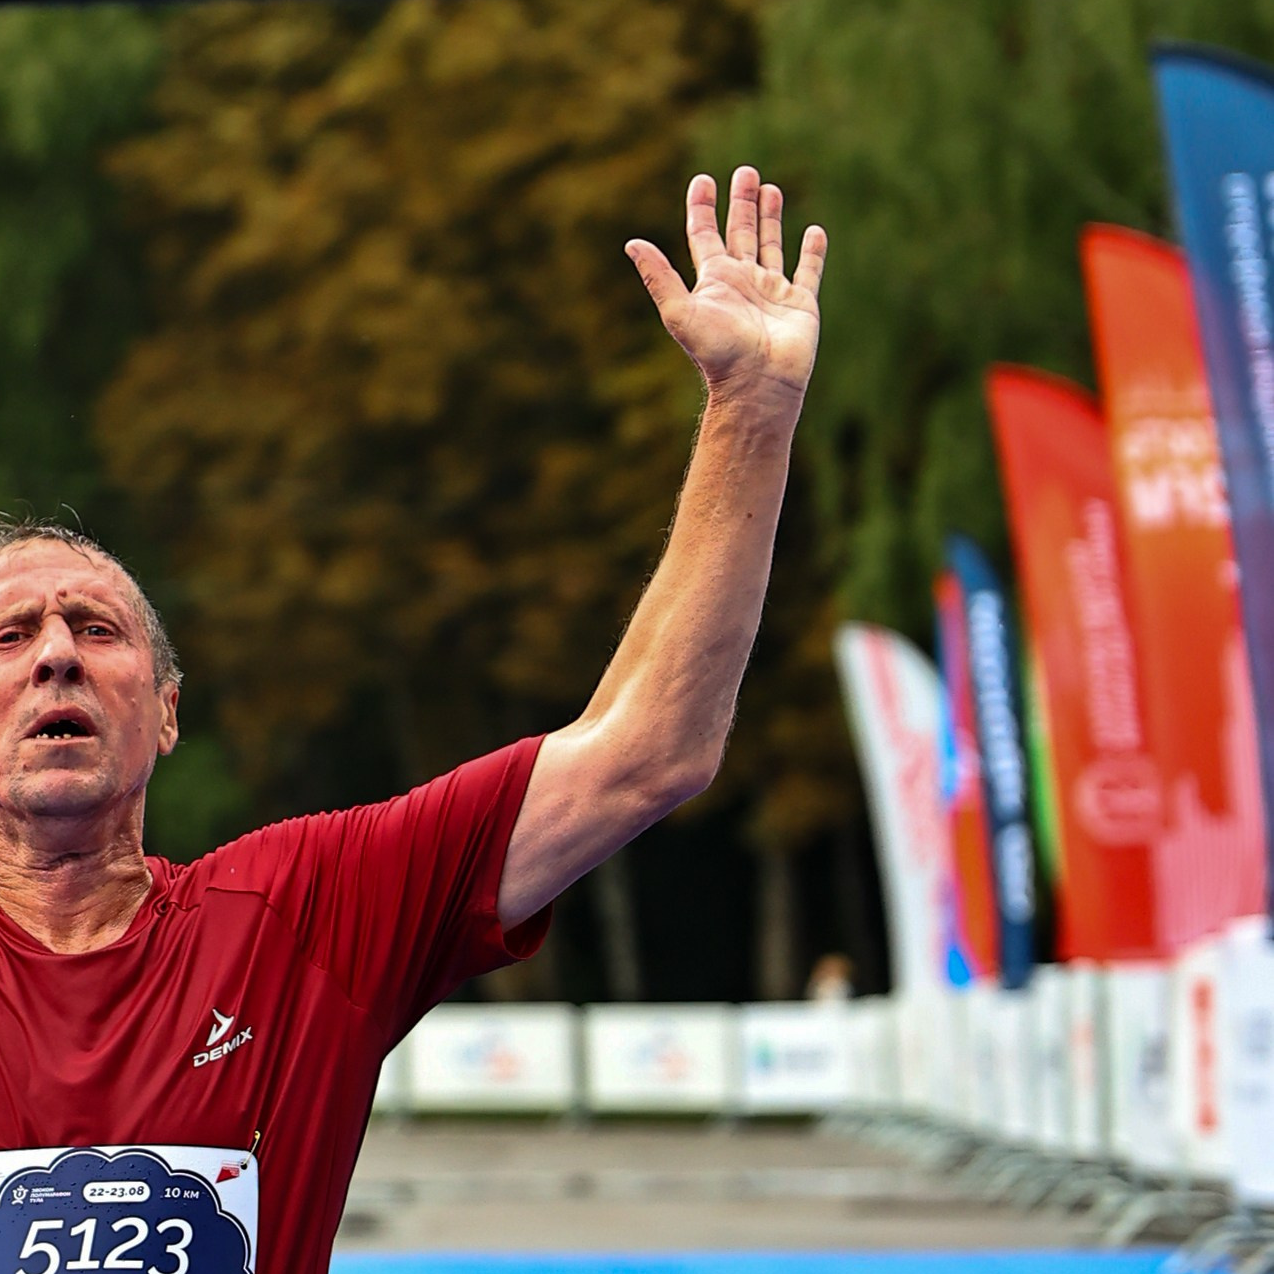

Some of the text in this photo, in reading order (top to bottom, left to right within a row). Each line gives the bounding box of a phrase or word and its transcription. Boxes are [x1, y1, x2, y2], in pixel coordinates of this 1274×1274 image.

[193, 1026, 253, 1068] DEMIX
[89, 1185, 145, 1198] 22-23.08
[164, 1187, 181, 1198] 10
